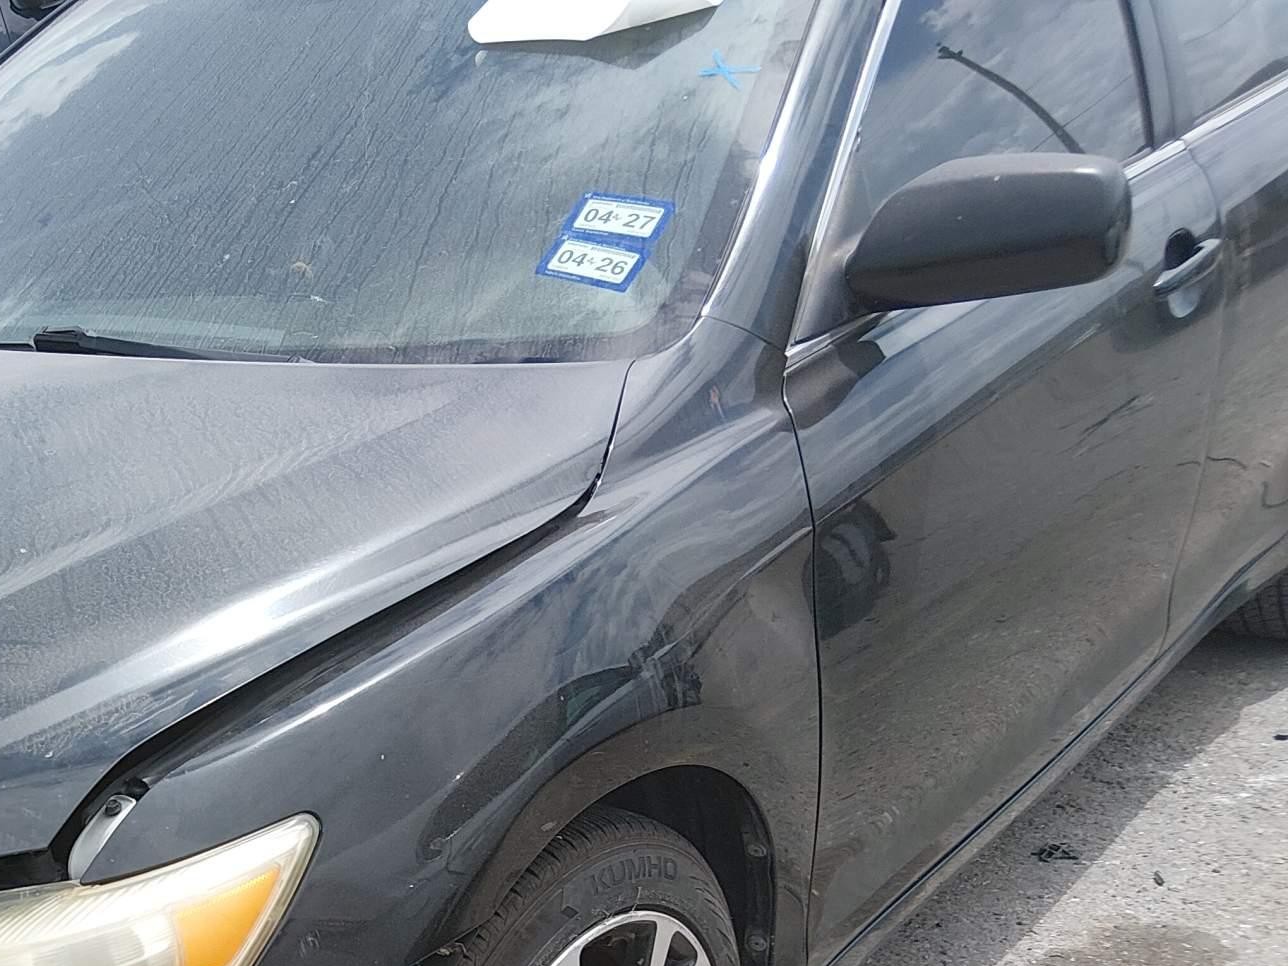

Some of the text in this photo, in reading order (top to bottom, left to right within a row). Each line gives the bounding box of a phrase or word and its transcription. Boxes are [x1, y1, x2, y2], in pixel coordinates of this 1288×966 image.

[584, 208, 614, 224] 04
[622, 213, 657, 230] 27
[557, 250, 588, 267] 04
[594, 257, 628, 275] 26
[590, 855, 678, 896] KUMHO
